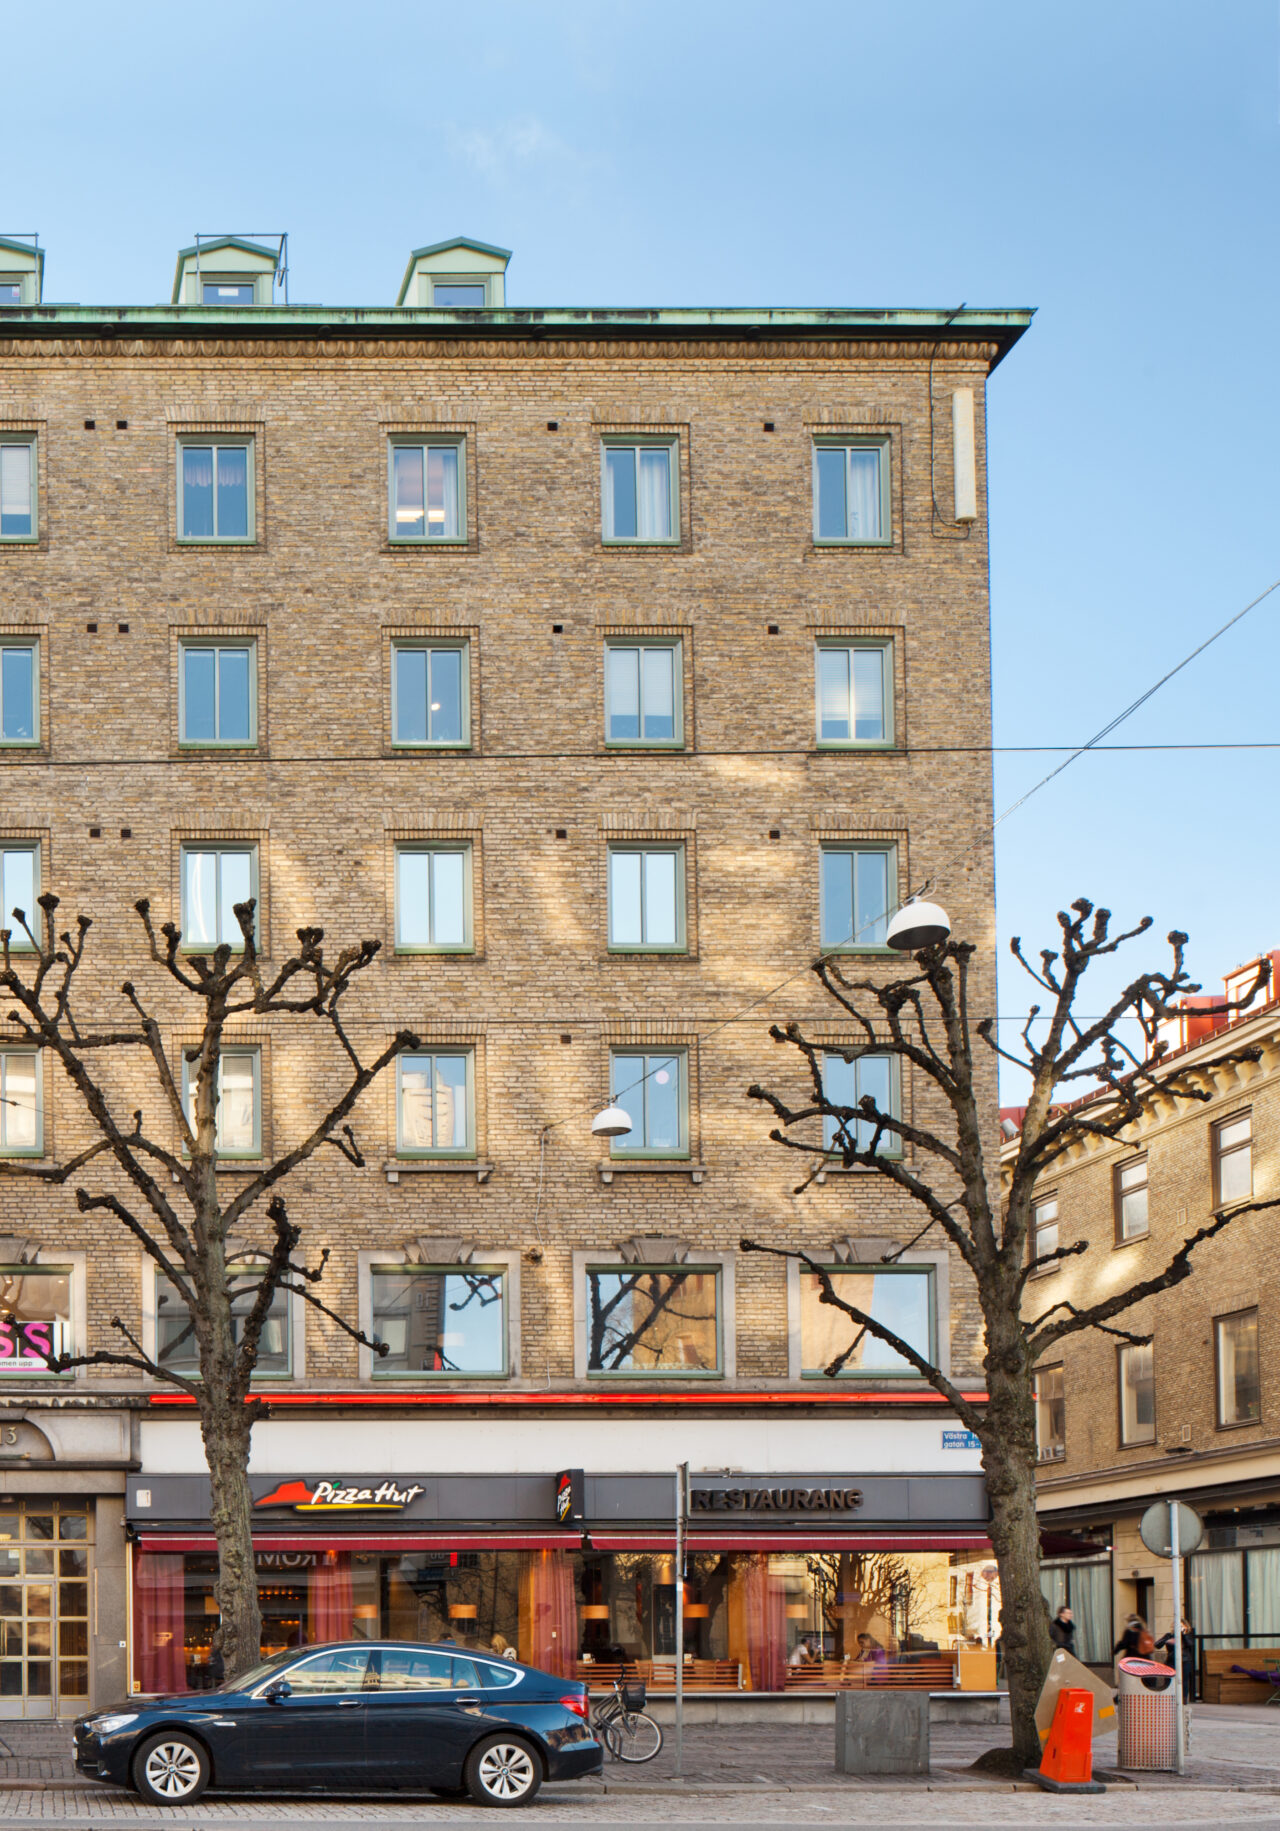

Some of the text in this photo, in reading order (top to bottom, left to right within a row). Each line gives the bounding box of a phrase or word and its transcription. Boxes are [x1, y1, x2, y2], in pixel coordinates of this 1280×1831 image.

[943, 1432, 968, 1440] Västra
[943, 1440, 965, 1449] gatan
[310, 1481, 425, 1505] Pizza Hut
[690, 1487, 865, 1511] RESTAURANG
